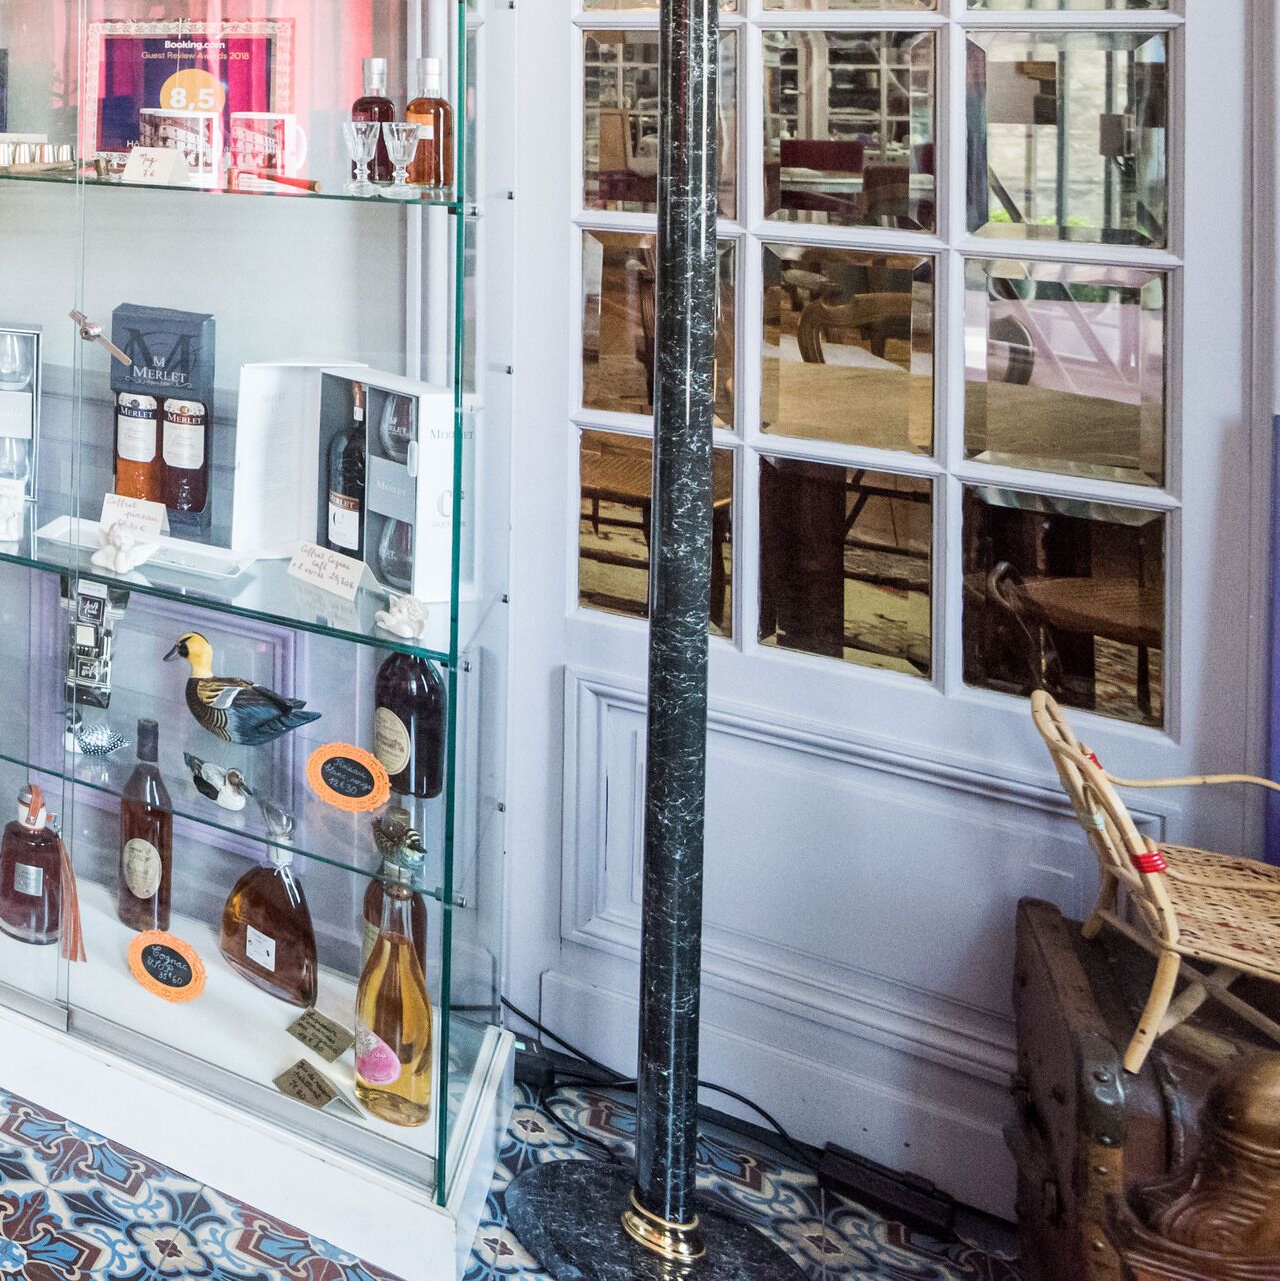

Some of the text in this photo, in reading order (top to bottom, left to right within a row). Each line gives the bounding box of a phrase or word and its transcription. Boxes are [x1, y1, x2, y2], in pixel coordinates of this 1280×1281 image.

[164, 40, 225, 50] Booking.com
[141, 51, 166, 60] Guest
[166, 52, 195, 60] Review
[229, 52, 250, 60] 2018
[169, 86, 215, 110] 8,5
[132, 366, 188, 384] MERLET
[120, 406, 153, 419] MERLET
[167, 412, 203, 425] MERLET
[151, 944, 189, 971] Cognac
